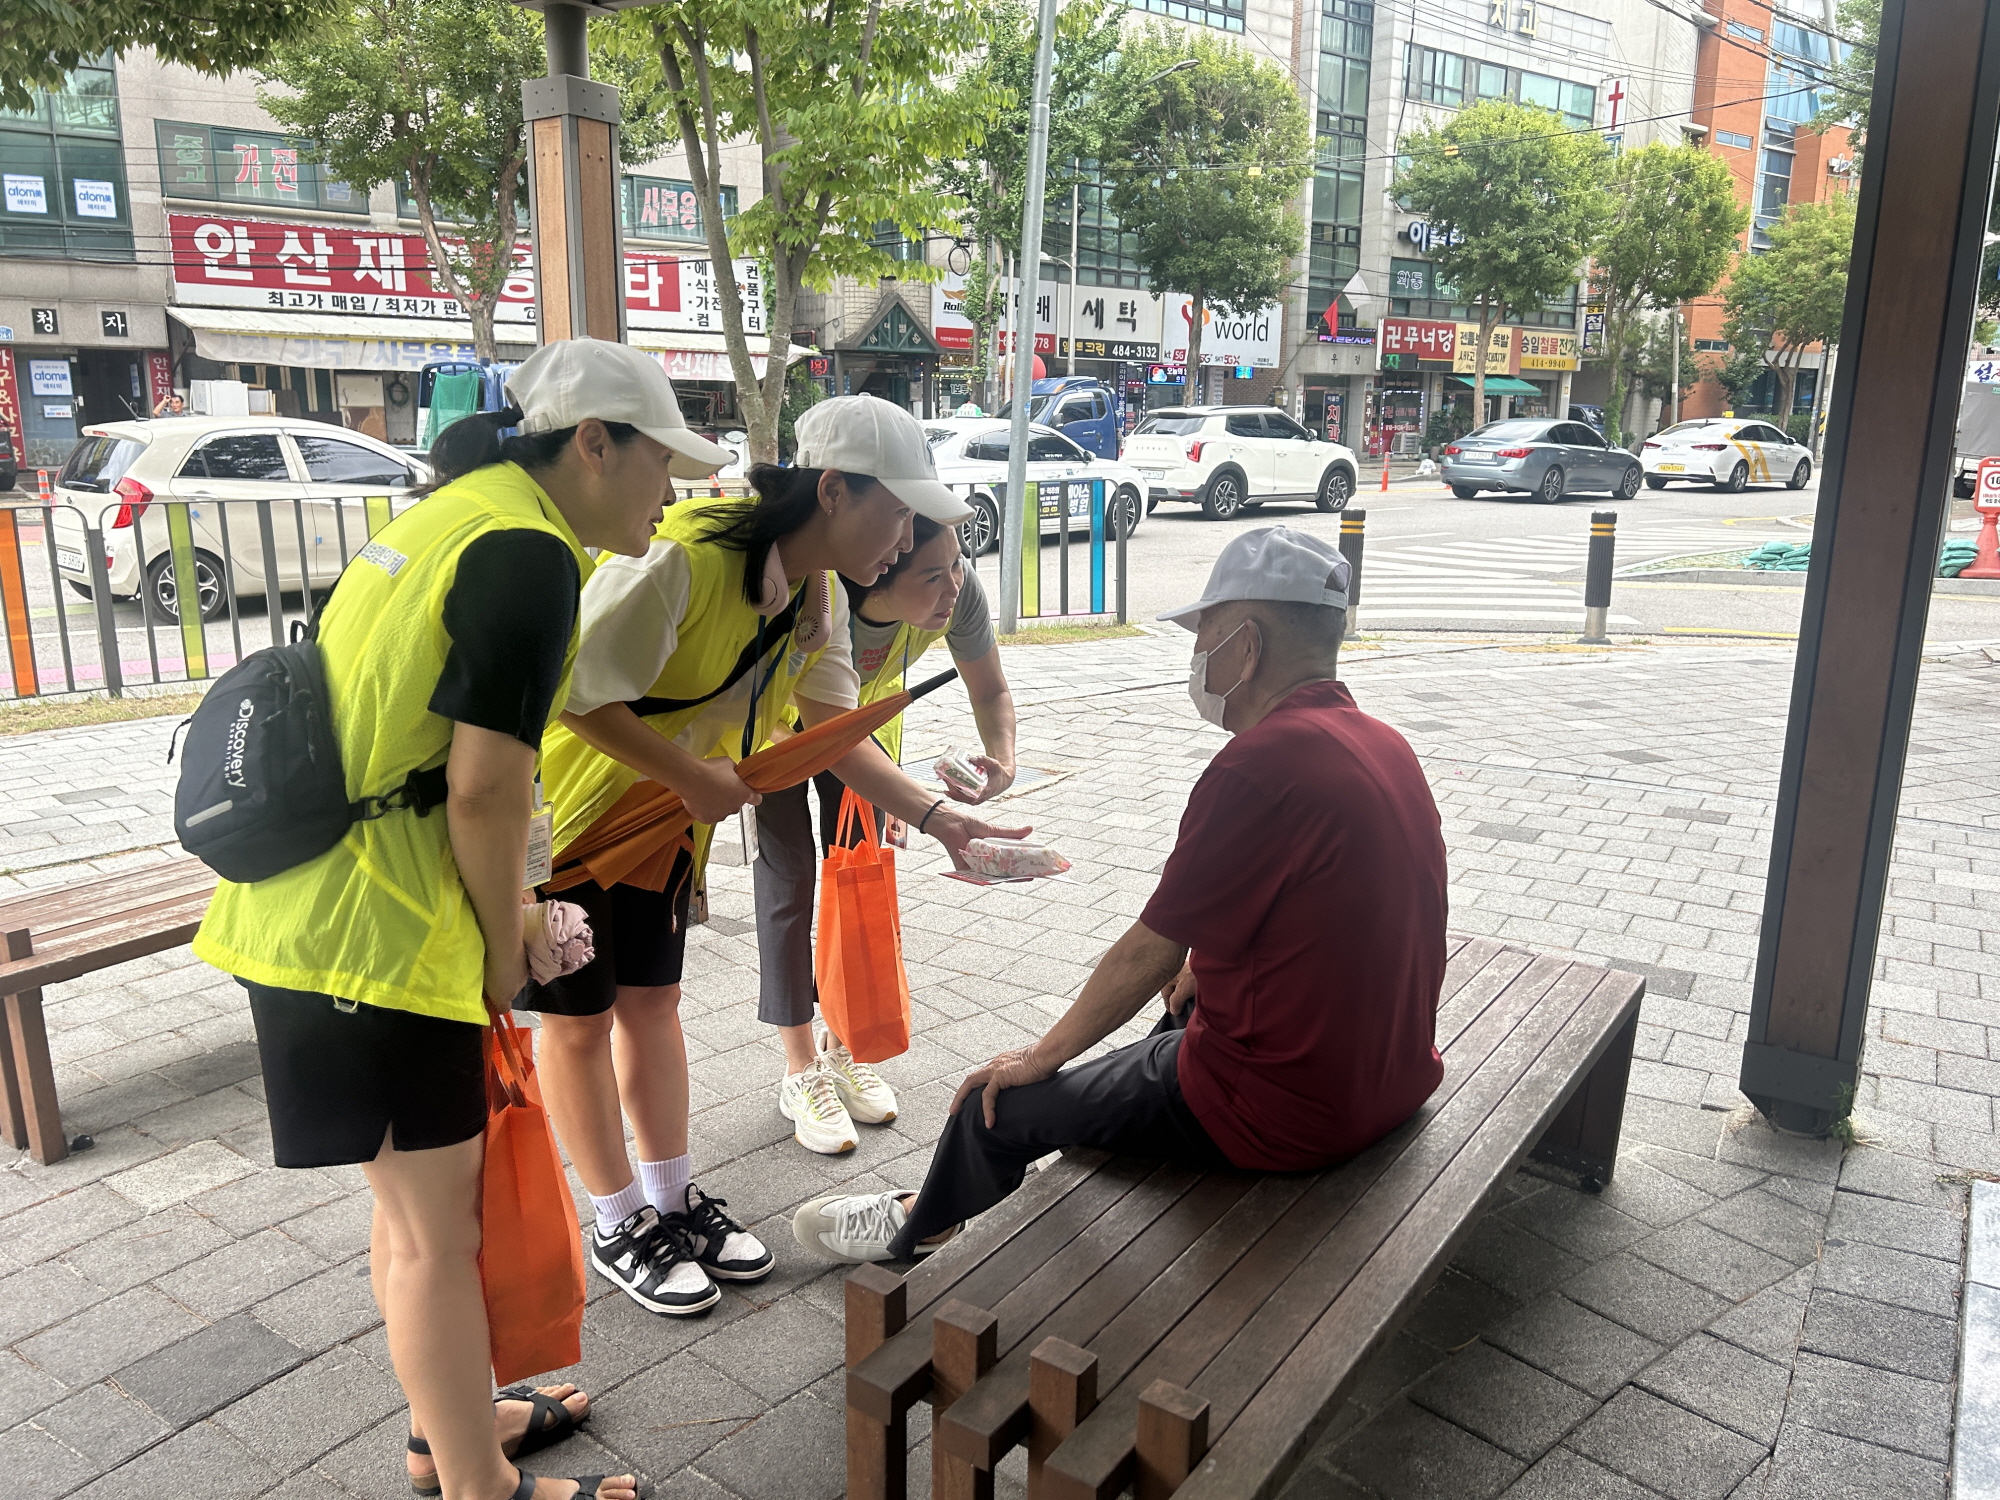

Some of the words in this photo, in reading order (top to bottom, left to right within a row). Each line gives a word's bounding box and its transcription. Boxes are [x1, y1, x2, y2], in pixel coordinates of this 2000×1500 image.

[233, 144, 298, 192] 가전
[694, 261, 758, 280] 에컨
[1397, 270, 1423, 290] 와동
[267, 291, 324, 309] 최고가
[332, 295, 366, 311] 매입
[385, 297, 436, 315] 최저가
[695, 295, 760, 314] 가전구
[696, 313, 761, 331] 컴터
[1082, 297, 1137, 332] 세탁
[1215, 313, 1269, 342] world
[1112, 344, 1157, 358] 484-3132
[1164, 350, 1172, 359] kt
[1174, 350, 1185, 359] 5G
[1531, 358, 1566, 369] 414-9940
[1327, 405, 1341, 443] 치과
[228, 704, 254, 788] Discovery
